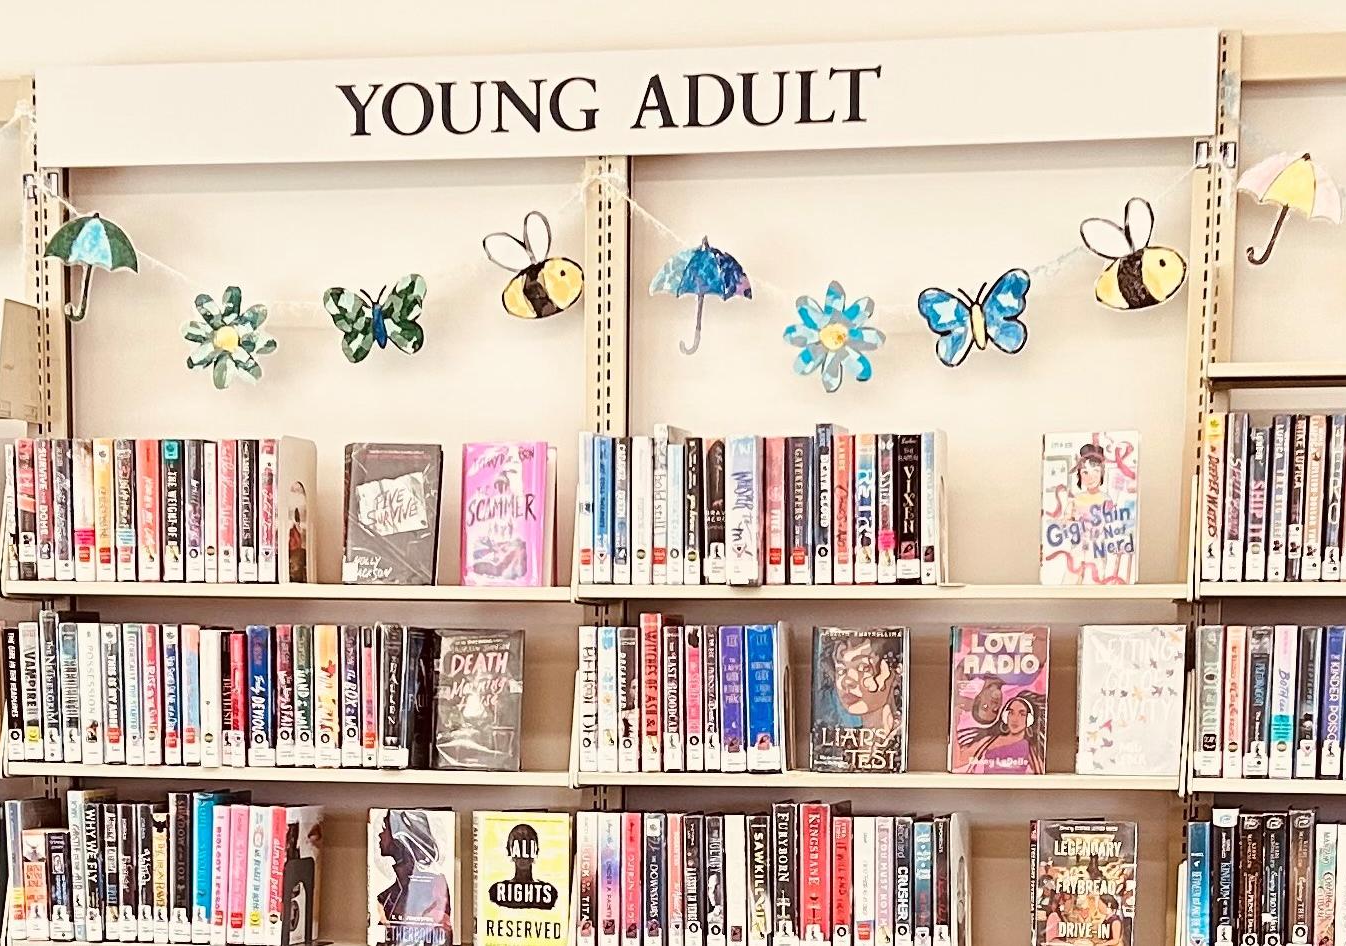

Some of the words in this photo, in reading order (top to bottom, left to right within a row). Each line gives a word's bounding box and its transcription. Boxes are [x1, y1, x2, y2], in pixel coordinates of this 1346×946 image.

[335, 78, 599, 137] YOUNG
[630, 65, 882, 129] ADULT
[38, 448, 48, 490] SURVIVE
[167, 471, 177, 488] THE
[1207, 454, 1221, 494] DEEPER
[1293, 449, 1305, 489] LUPICA
[653, 473, 666, 500] hold
[794, 448, 804, 521] GATEKEEPERS
[167, 491, 177, 523] WEIGHT
[375, 487, 405, 511] FIVE
[467, 493, 536, 526] SCAMMER
[1251, 480, 1264, 519] SHIP
[366, 500, 418, 527] SURVIVE
[654, 504, 667, 530] still
[1089, 500, 1131, 527] Shin
[1207, 495, 1219, 538] WATERS
[1104, 524, 1127, 539] Not
[1093, 534, 1135, 559] Nerd
[644, 631, 658, 675] WITCHES
[971, 633, 1035, 654] LOVE
[450, 652, 509, 675] DEATH
[963, 654, 1040, 675] RADIO
[86, 644, 95, 714] POSSESSION
[1328, 660, 1341, 700] KINDER
[645, 695, 657, 715] ASH
[844, 749, 898, 770] TEST
[85, 809, 97, 838] WHY
[86, 839, 97, 858] WE
[271, 838, 281, 876] almost
[510, 840, 538, 859] ALL
[778, 812, 790, 883] FURYBORN
[808, 813, 821, 886] KINGSBANE
[879, 837, 888, 859] YOU
[1054, 841, 1122, 858] LEGENDARY
[87, 860, 98, 883] FLY
[754, 832, 765, 896] SAWKILL
[879, 862, 888, 890] MUST
[496, 883, 552, 904] RIGHTS
[897, 866, 908, 920] CRUSHER
[1056, 879, 1116, 896] FRYBREAD
[384, 926, 446, 944] ETHERBOUND
[486, 920, 561, 940] RESERVED
[1058, 922, 1110, 939] DRIVE-IN
